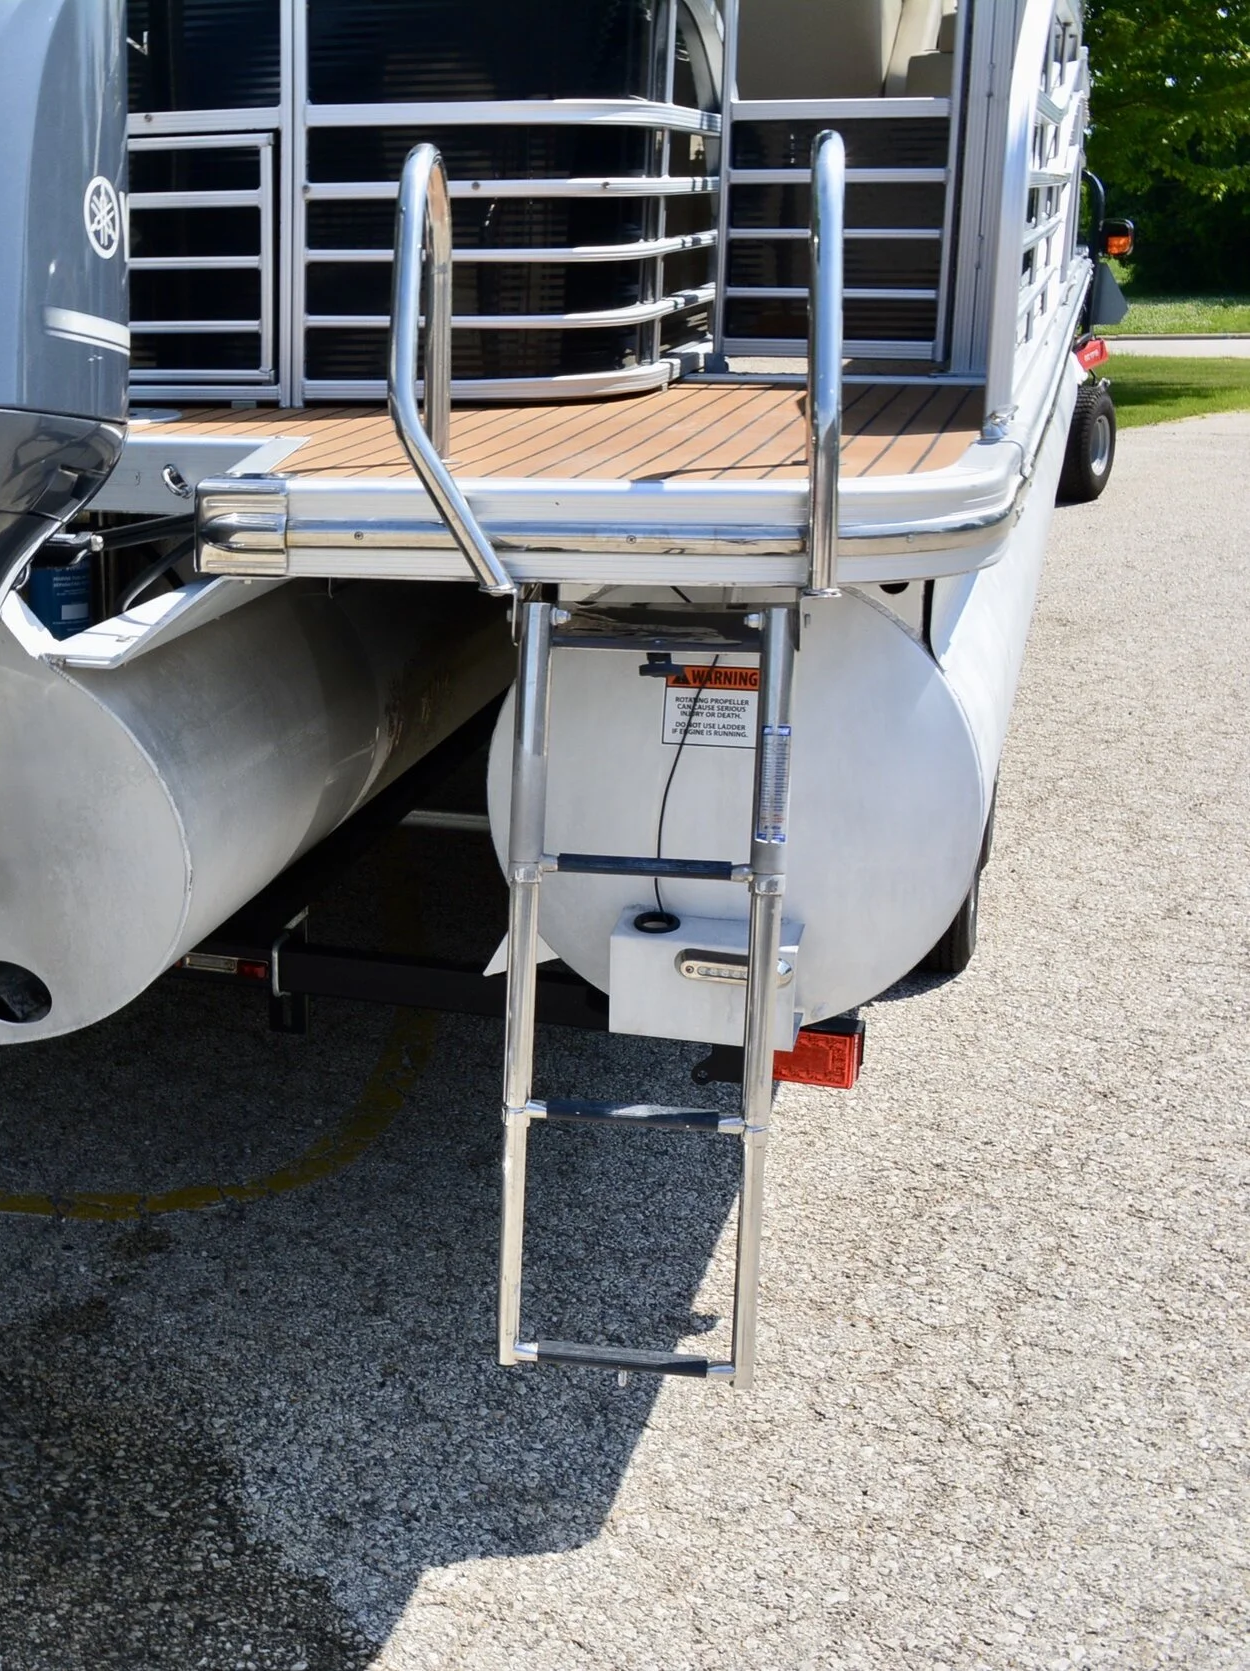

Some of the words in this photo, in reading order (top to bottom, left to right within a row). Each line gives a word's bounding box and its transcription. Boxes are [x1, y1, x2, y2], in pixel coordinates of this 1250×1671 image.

[691, 669, 758, 687] WARNING
[710, 698, 750, 706] PROPELLER
[693, 704, 715, 712] CAUSE
[716, 705, 746, 713] SERIOUS
[717, 723, 746, 731] LADDER
